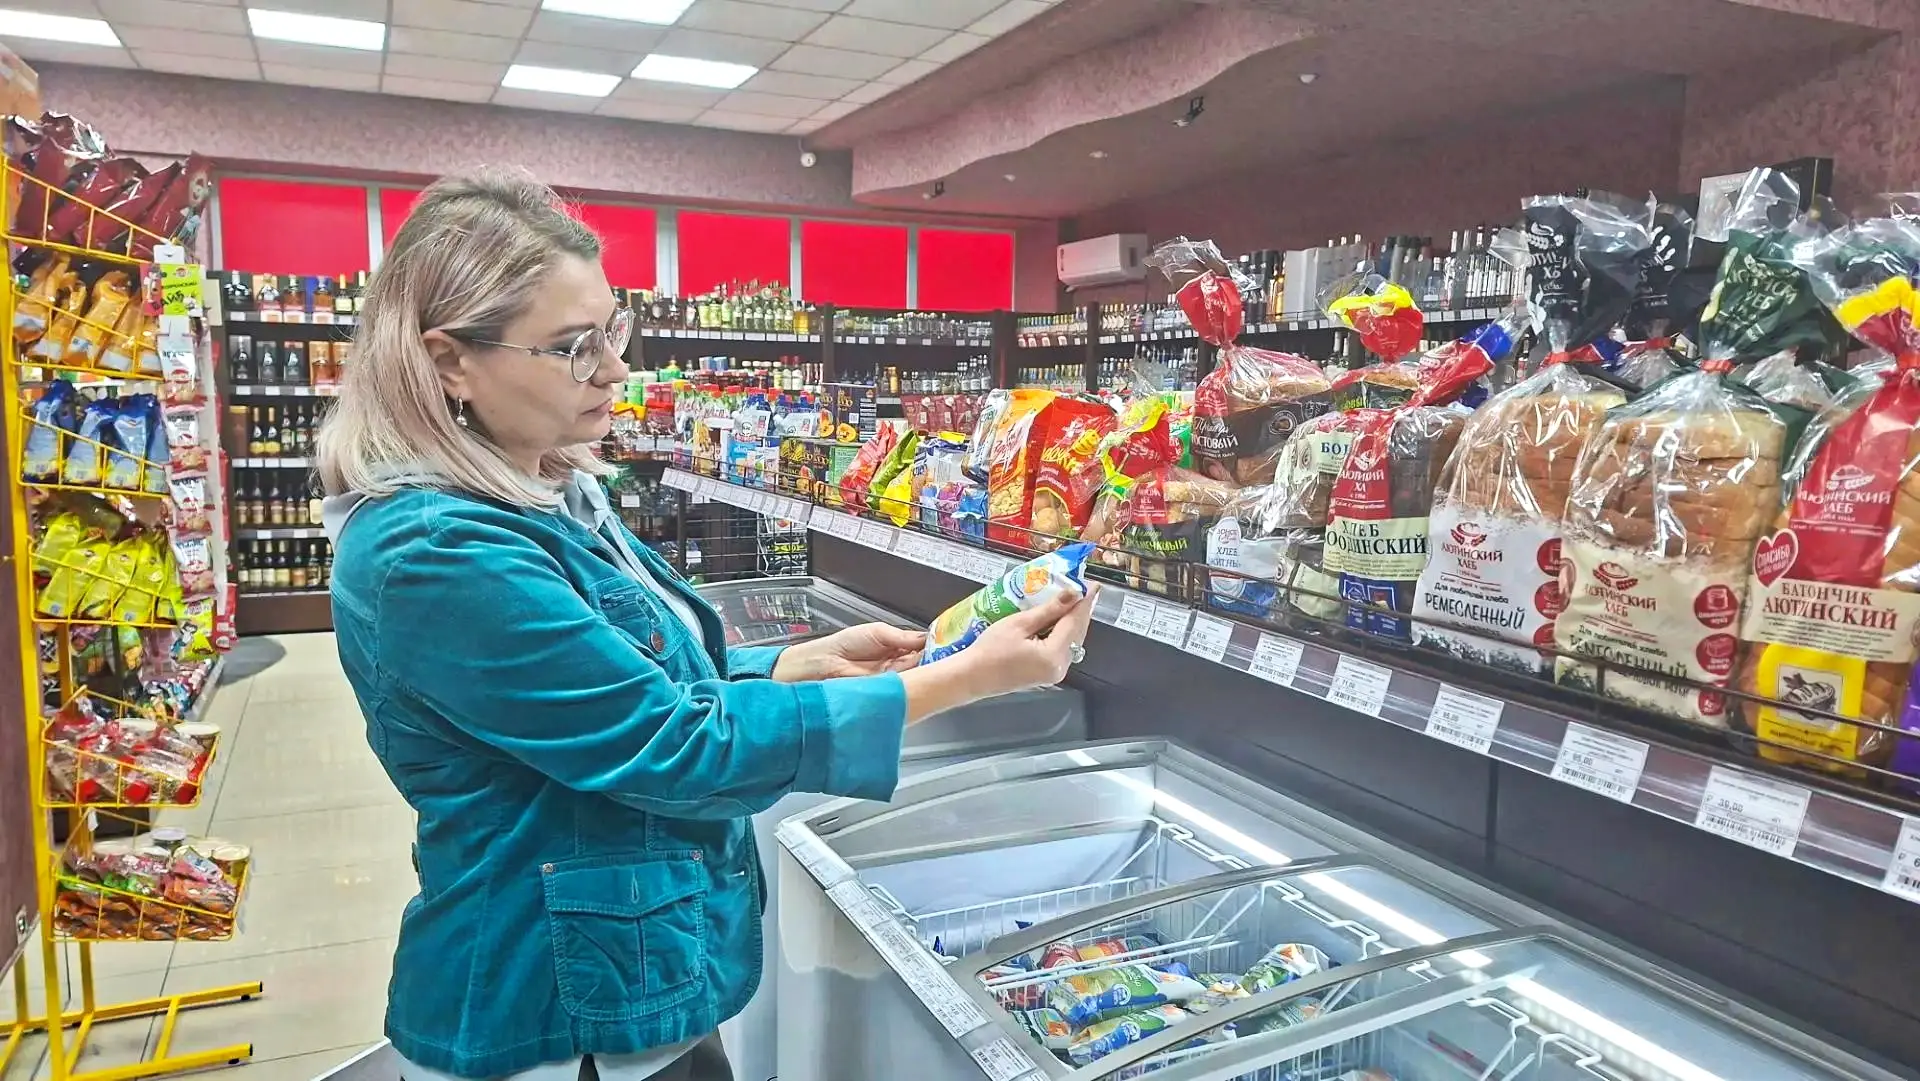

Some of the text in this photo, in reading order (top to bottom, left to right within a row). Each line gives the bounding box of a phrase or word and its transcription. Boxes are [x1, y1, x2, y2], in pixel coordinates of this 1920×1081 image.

[1441, 543, 1503, 562] АЮТИНСКИЙ
[1457, 557, 1478, 570] ХЛЕБ
[1757, 543, 1791, 570] СПАСИБО
[1434, 582, 1449, 591] Для
[1782, 582, 1873, 606] БАТОНЧИК
[1425, 592, 1526, 630] РЕМЕСЛЕННЫЙ
[1762, 597, 1899, 631] АЮТИНСКИЙ
